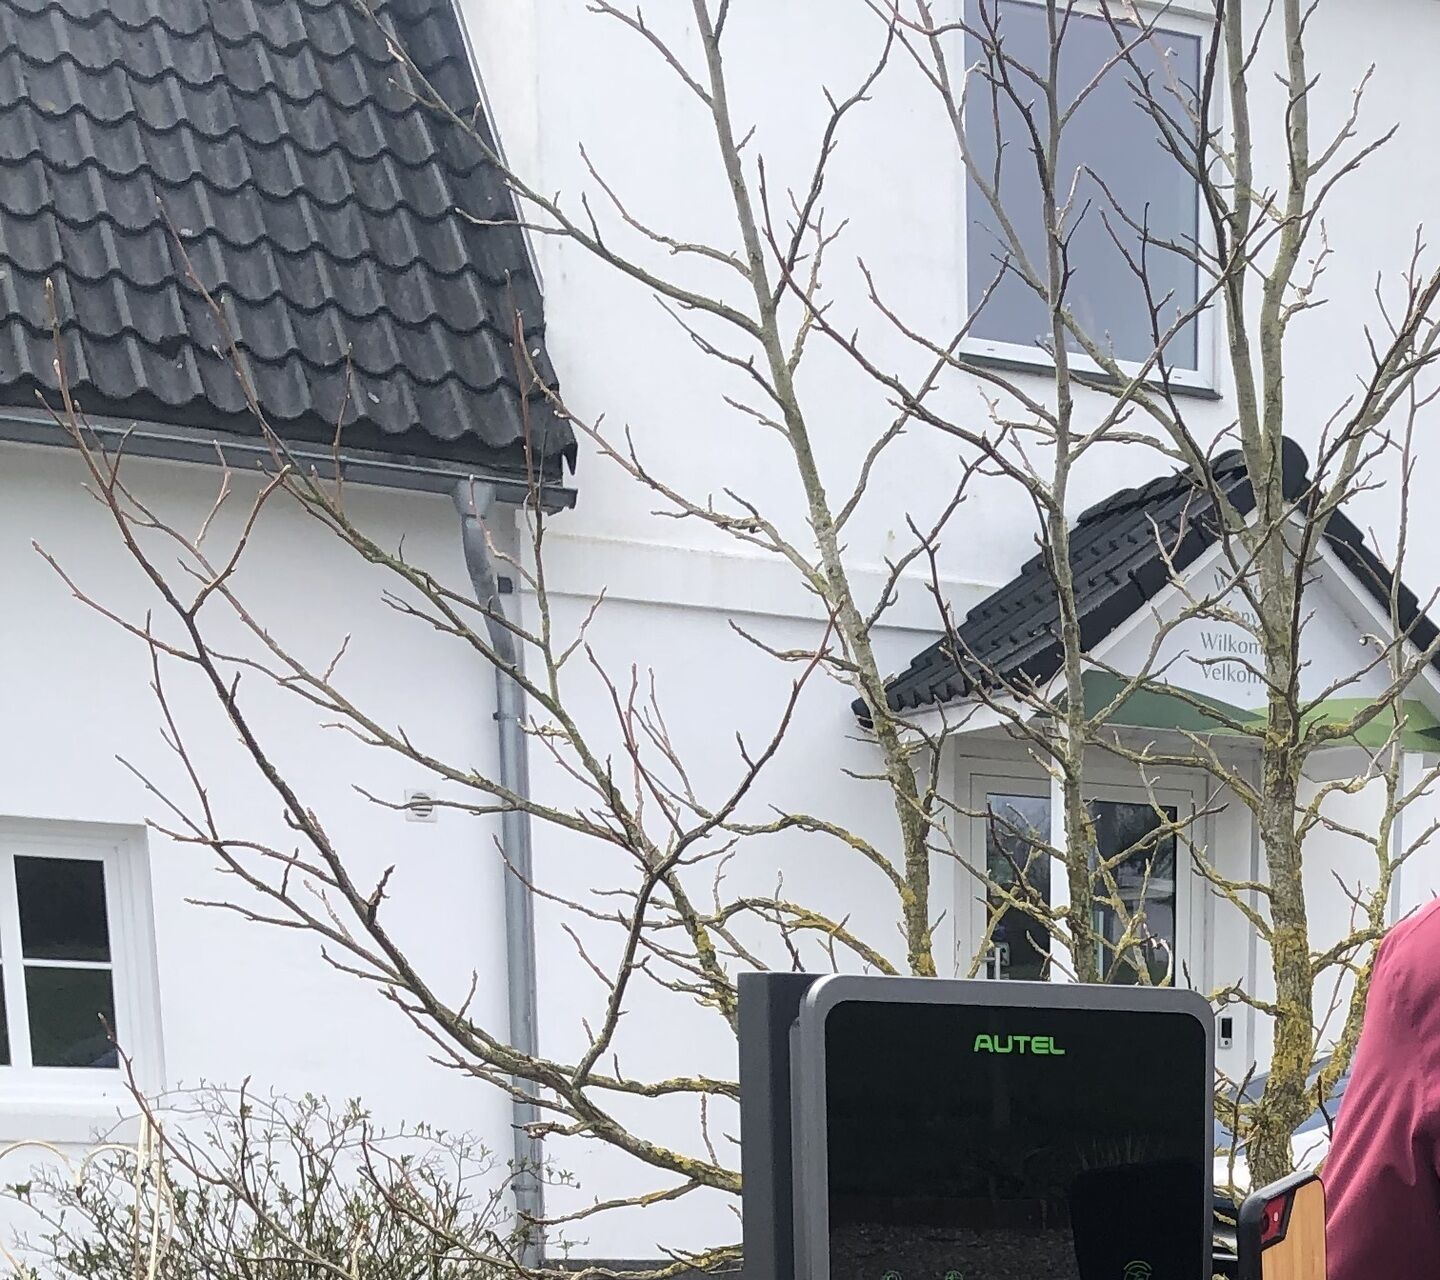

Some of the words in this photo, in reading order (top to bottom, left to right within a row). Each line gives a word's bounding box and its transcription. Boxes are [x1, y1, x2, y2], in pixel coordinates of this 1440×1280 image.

[1200, 631, 1264, 656] Wilkom
[1201, 663, 1263, 684] Velkom
[973, 1034, 1066, 1055] AUTEL
